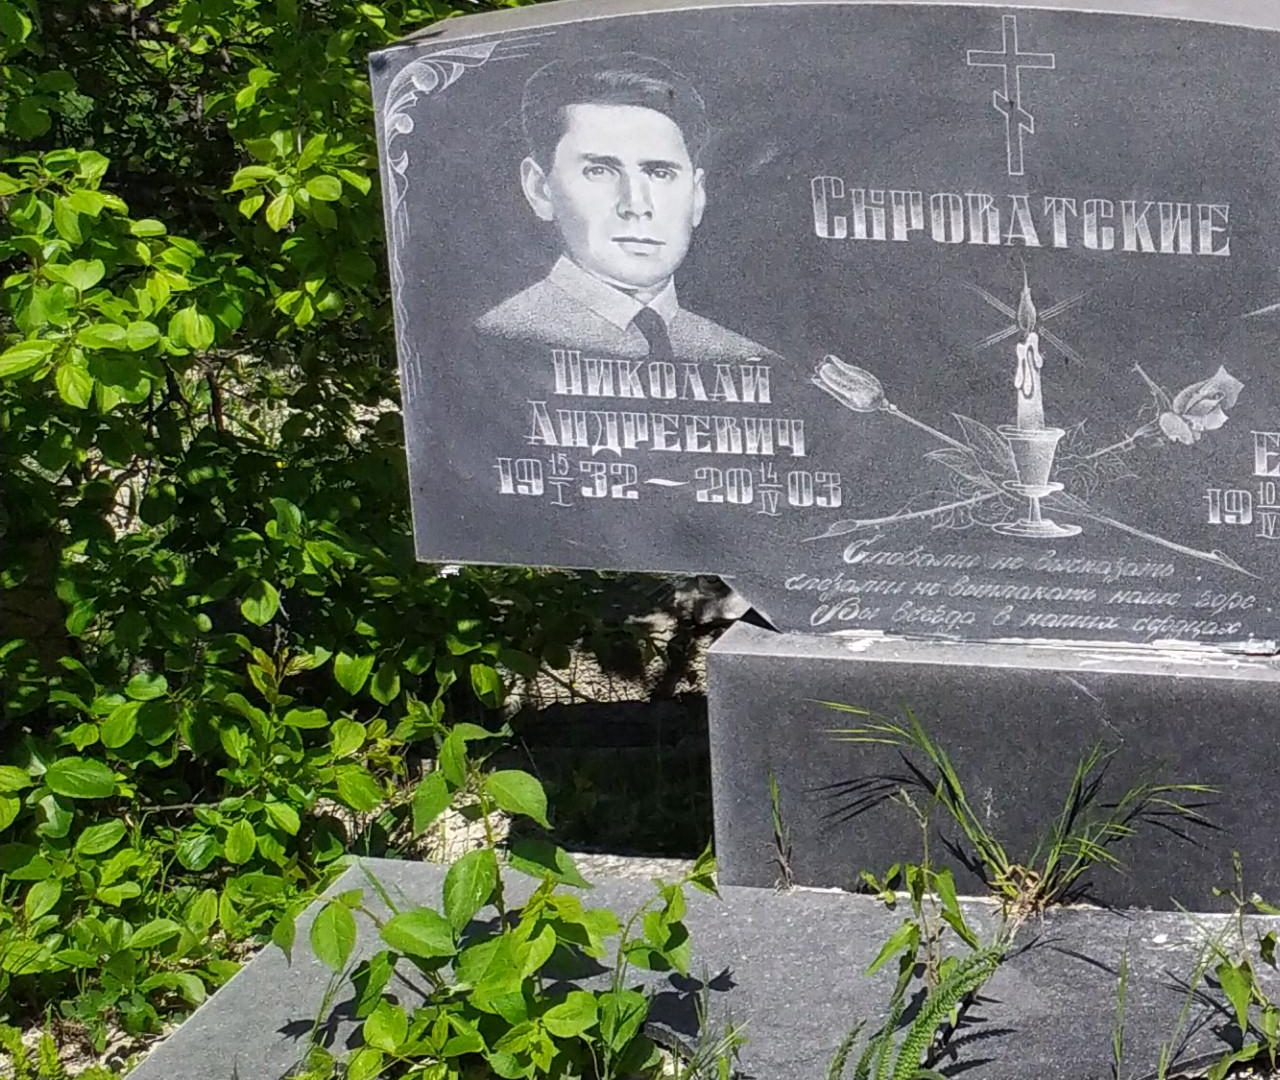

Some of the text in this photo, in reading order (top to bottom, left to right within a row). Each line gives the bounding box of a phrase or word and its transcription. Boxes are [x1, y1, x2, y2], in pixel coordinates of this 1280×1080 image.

[550, 349, 772, 403] НИКОЛАЙ
[523, 401, 806, 457] АНДРЕЕВИЧ
[990, 556, 1024, 569] не
[910, 580, 941, 596] не
